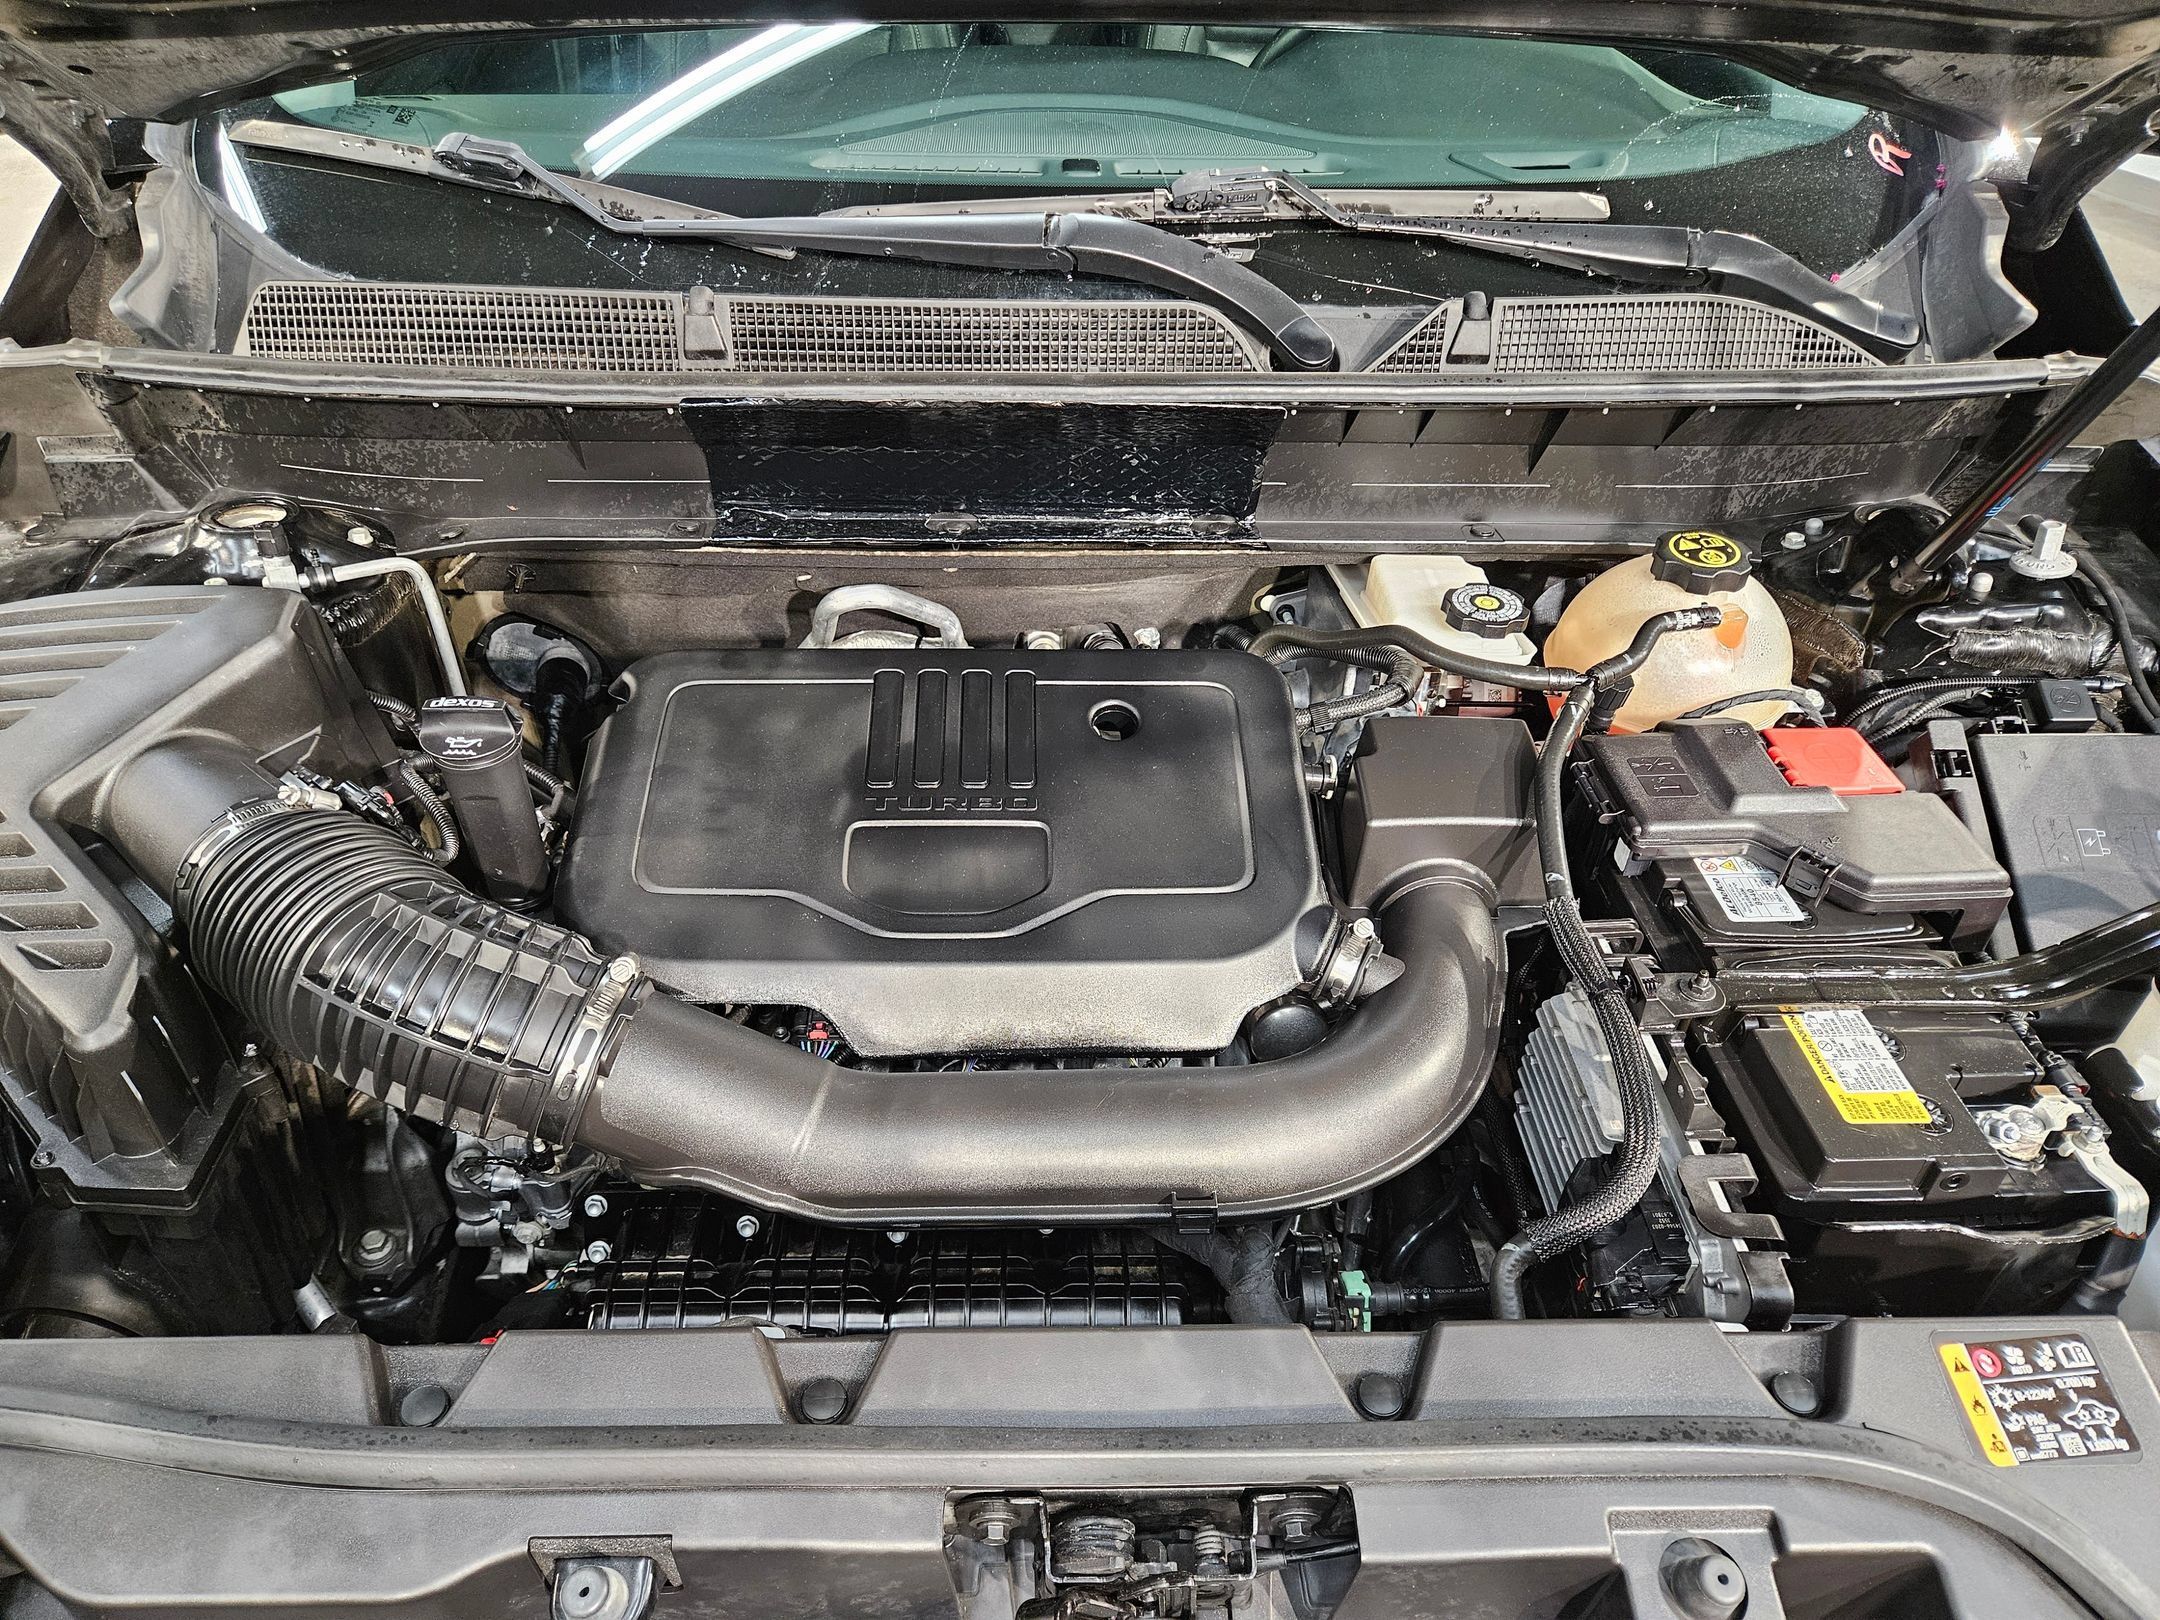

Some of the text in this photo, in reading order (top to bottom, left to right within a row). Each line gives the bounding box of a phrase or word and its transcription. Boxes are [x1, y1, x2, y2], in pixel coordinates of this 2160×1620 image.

[1868, 133, 1912, 177] R
[429, 696, 499, 708] dexos
[864, 795, 1039, 812] TURBO
[1712, 877, 1741, 917] ACDelco
